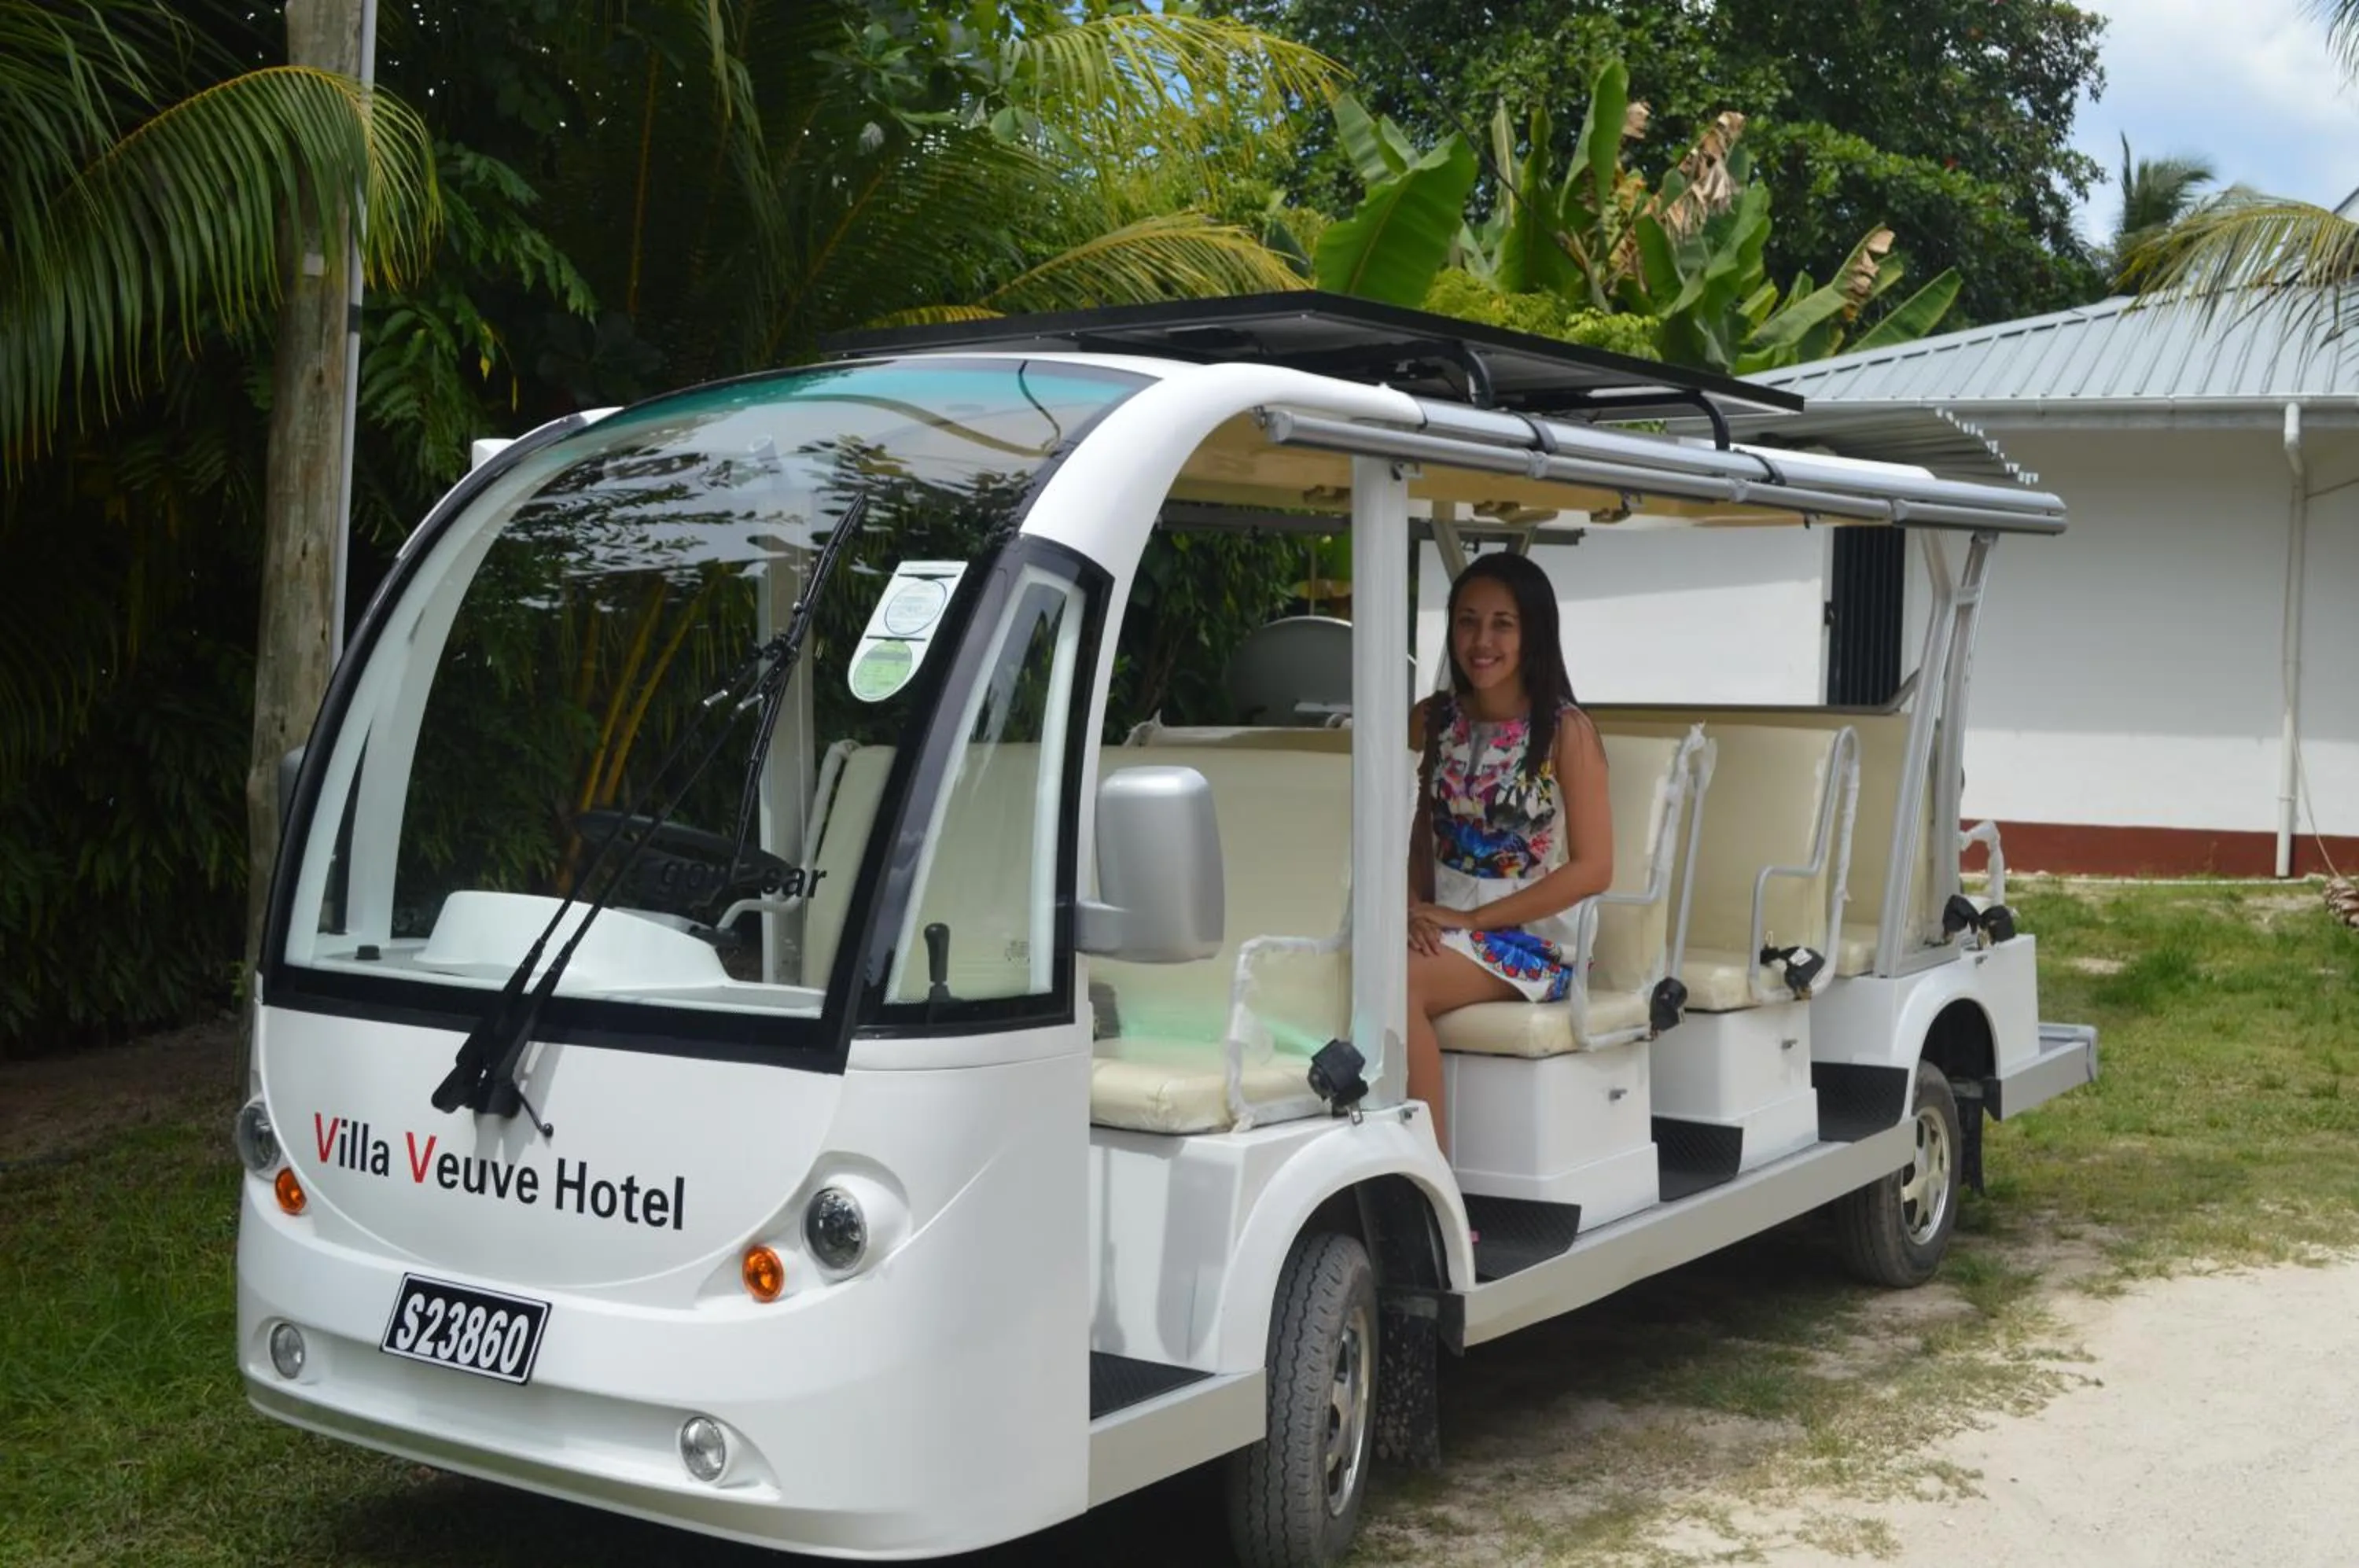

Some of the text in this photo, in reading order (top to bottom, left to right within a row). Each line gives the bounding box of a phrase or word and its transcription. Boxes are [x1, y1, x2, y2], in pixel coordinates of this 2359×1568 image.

[761, 866, 827, 897] car
[315, 1112, 685, 1230] Villa Veuve Hotel
[396, 1292, 529, 1374] S23860
